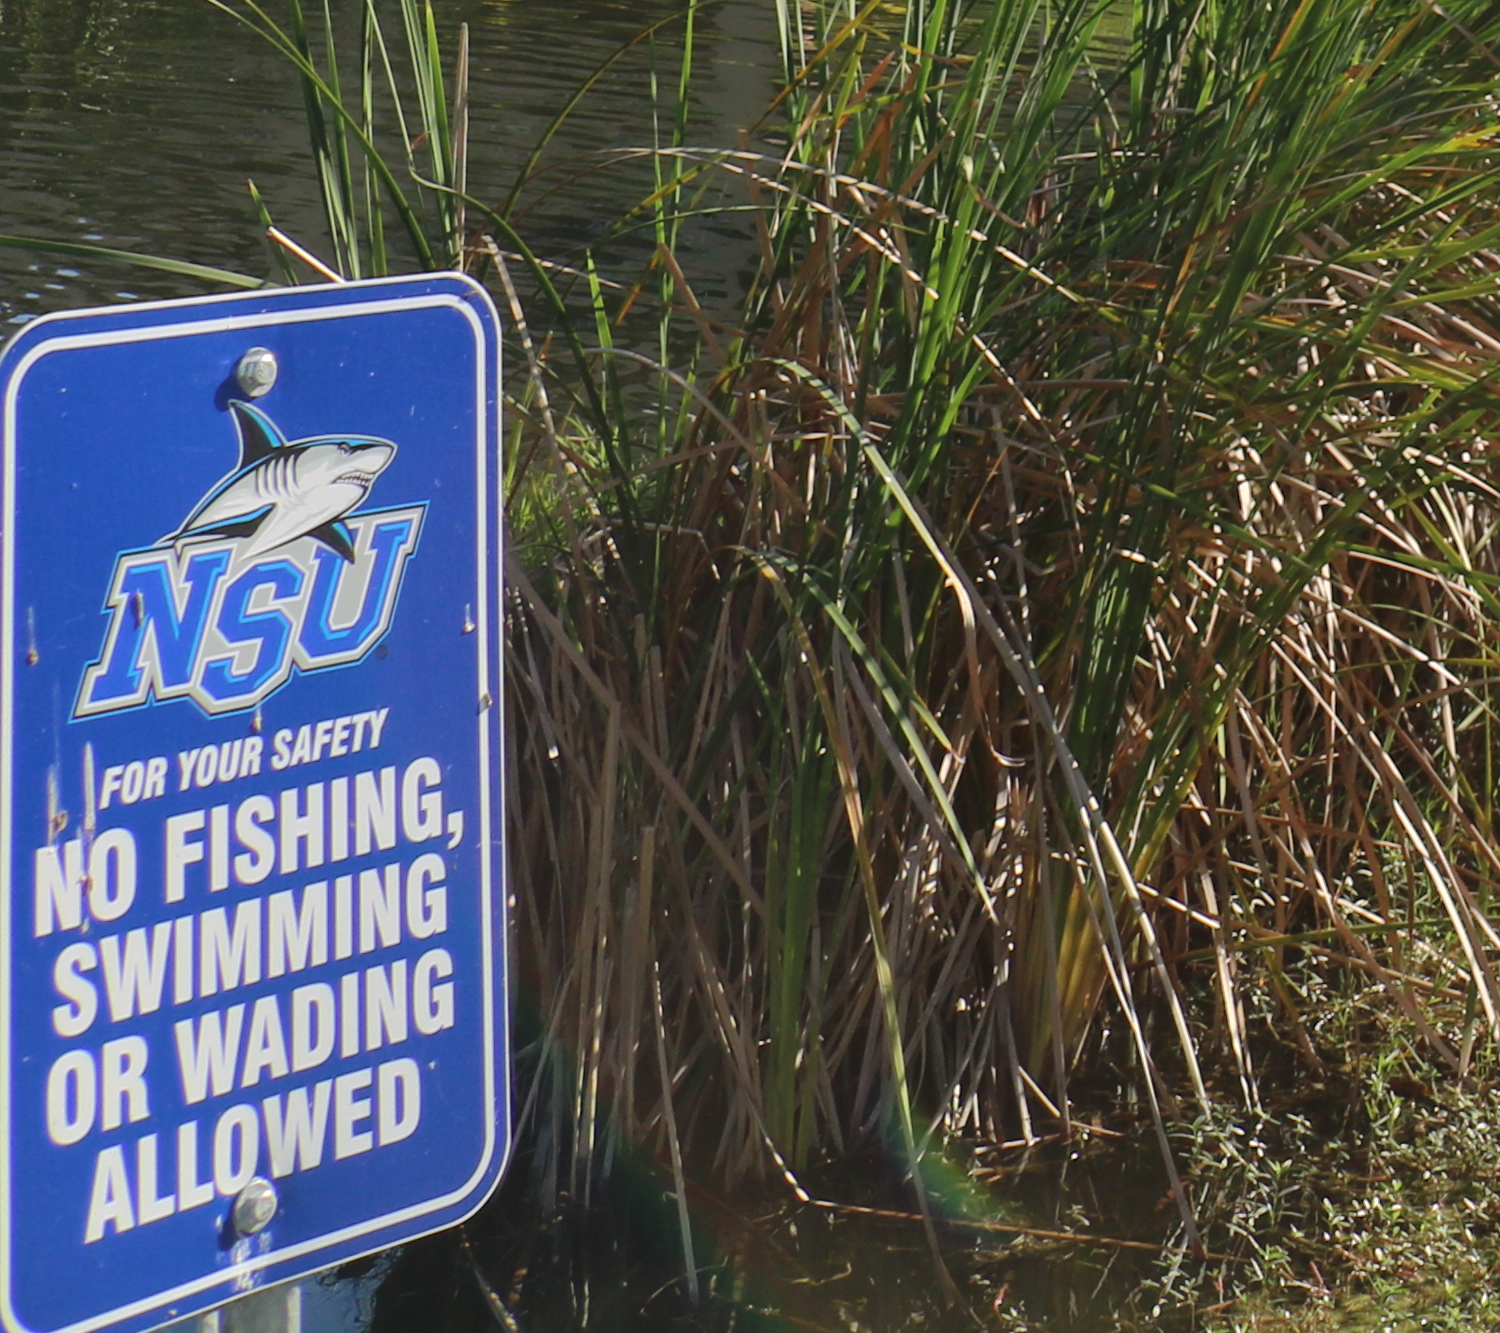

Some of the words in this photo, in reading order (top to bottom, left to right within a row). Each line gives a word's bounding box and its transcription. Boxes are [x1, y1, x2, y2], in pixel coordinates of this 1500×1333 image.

[76, 503, 428, 721] NSU
[34, 827, 137, 938] NO
[166, 757, 464, 904] FISHING,
[99, 757, 168, 810] FOR
[179, 735, 263, 792] YOUR
[270, 707, 389, 771] SAFETY
[52, 853, 448, 1037] SWIMMING
[46, 1035, 150, 1146] OR
[175, 948, 455, 1105] WADING
[84, 1058, 421, 1245] ALLOWED
